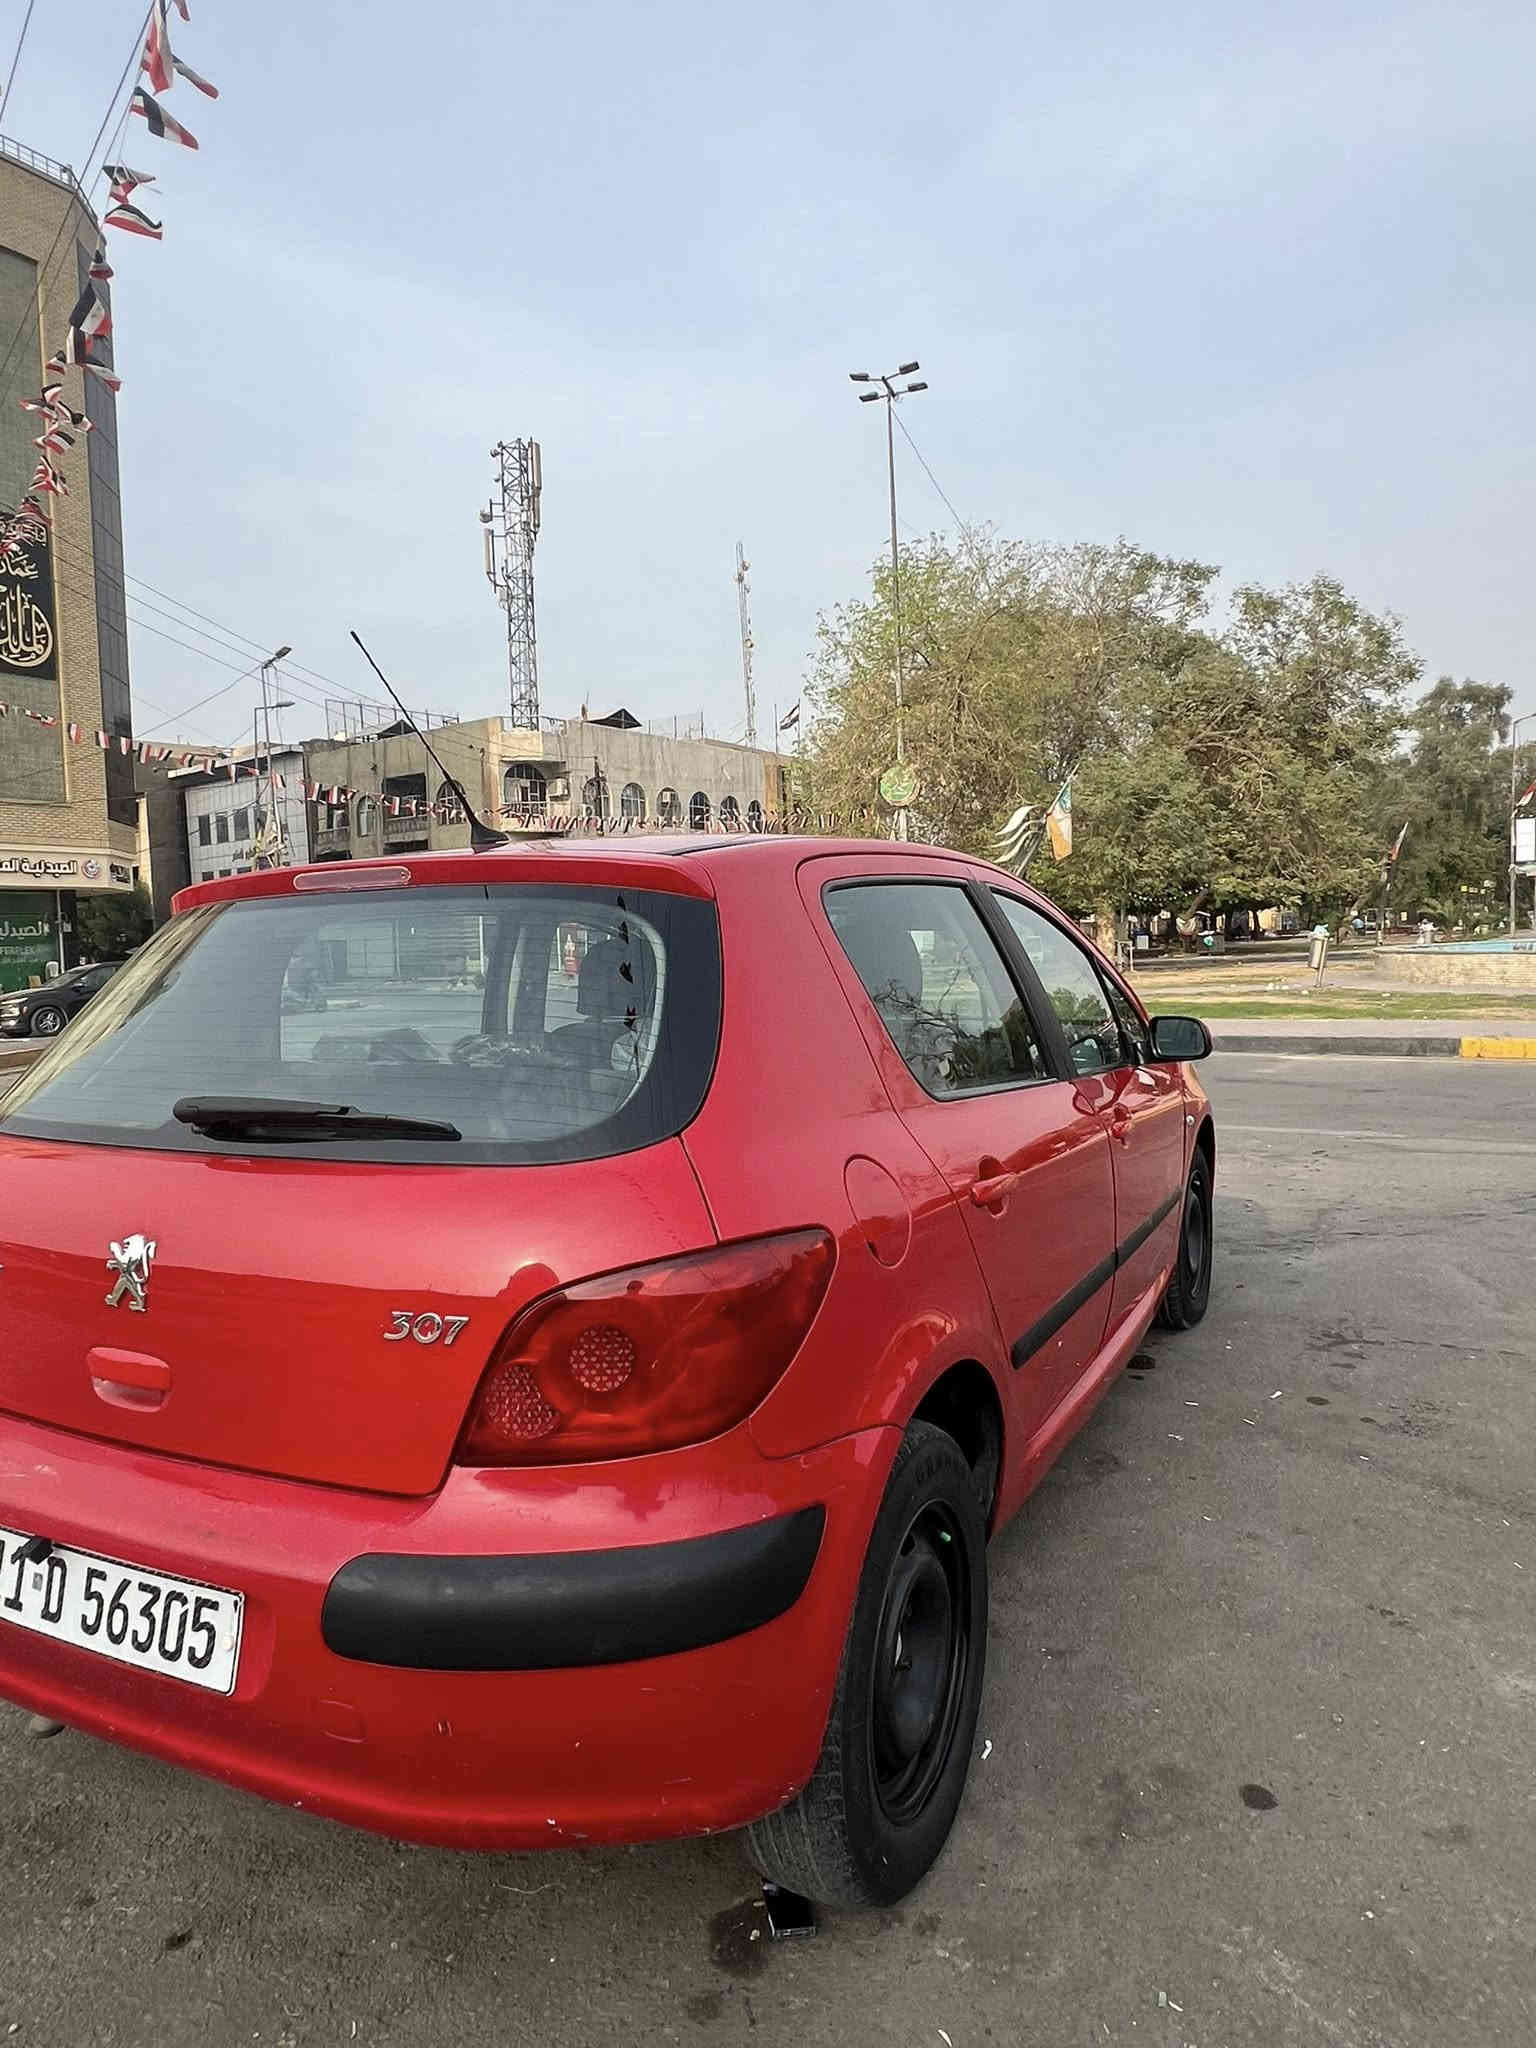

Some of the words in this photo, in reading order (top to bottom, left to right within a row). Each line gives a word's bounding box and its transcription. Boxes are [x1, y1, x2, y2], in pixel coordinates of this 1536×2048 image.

[0, 858, 19, 872] الم
[21, 857, 77, 877] الصيدلية
[384, 1311, 469, 1344] 307
[0, 1540, 23, 1612] 1
[81, 1567, 219, 1669] 56305
